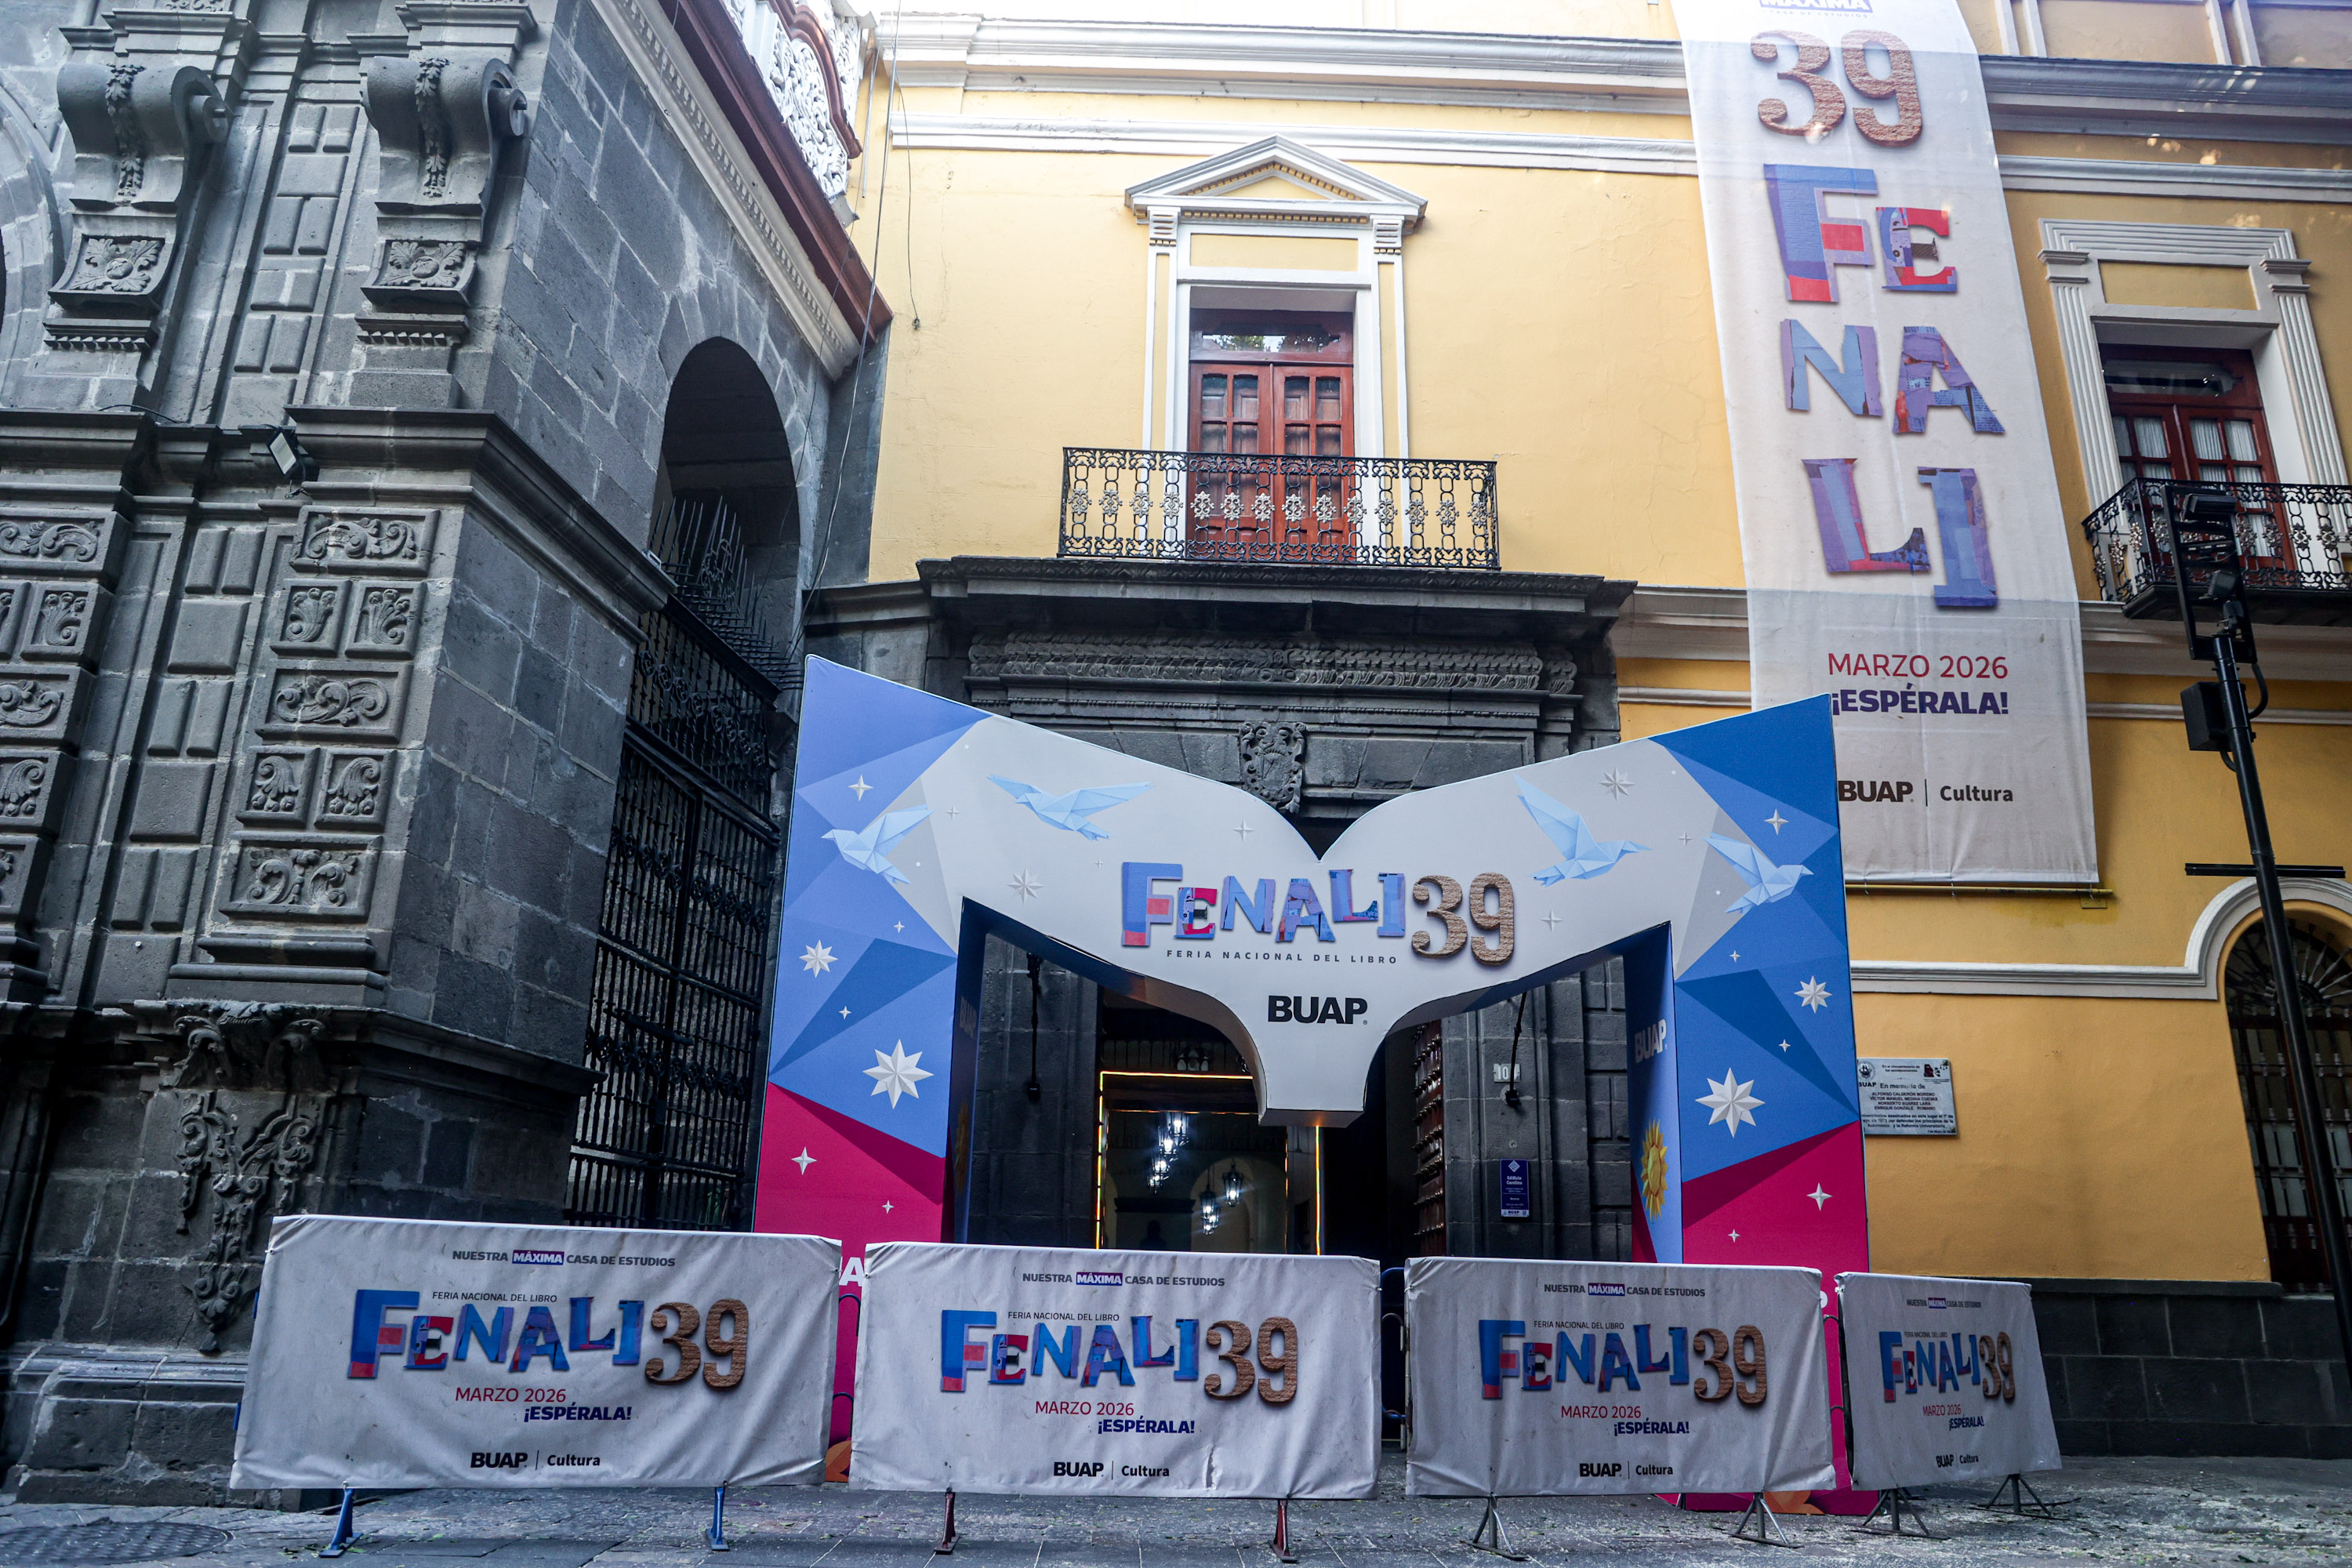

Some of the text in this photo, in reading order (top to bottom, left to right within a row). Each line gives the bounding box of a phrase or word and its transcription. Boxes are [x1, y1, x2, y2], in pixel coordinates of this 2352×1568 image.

[1751, 29, 1922, 147] 39
[1763, 163, 1958, 303] FE
[1780, 318, 2005, 435] NA
[1802, 458, 1998, 608] LI
[1828, 652, 2009, 679] MARZO 2026
[1832, 683, 2009, 715] ¡ESPÉRALA!
[1838, 780, 2013, 803] BUAP Cultura
[1167, 949, 1211, 958] FERIA
[1222, 951, 1302, 961] NACIONAL
[1351, 955, 1396, 964] LIBRO
[1268, 995, 1368, 1025] BUAP
[1634, 1018, 1667, 1063] BUAP
[452, 1250, 675, 1266] NUESTRA MÁXIMA CASA DE ESTUDIOS
[1022, 1272, 1225, 1287] NUESTRA MÁXIMA CASA DE ESTUDIOS
[432, 1290, 557, 1303] FERIA NACIONAL DEL LIBRO
[1544, 1283, 1705, 1297] NUESTRA MÁXIMA CASA DE ESTUDIOS
[1007, 1311, 1031, 1319] FERIA
[1033, 1312, 1075, 1320] NACIONAL
[1095, 1313, 1120, 1322] LIBRO
[455, 1387, 566, 1403] MARZO 2026
[524, 1402, 632, 1422] ¡ESPÉRALA!
[1036, 1401, 1134, 1416] MARZO 2026
[1561, 1406, 1642, 1418] MARZO 2026
[1922, 1404, 1962, 1417] MARZO 2026
[1098, 1415, 1195, 1434] ¡ESPÉRALA!
[1613, 1417, 1690, 1436] ¡ESPÉRALA!
[470, 1452, 601, 1468] BUAP Cultura
[1936, 1454, 1979, 1468] BUAP Cultura
[1053, 1461, 1170, 1477] BUAP Cultura
[1579, 1463, 1673, 1477] BUAP Cultura
